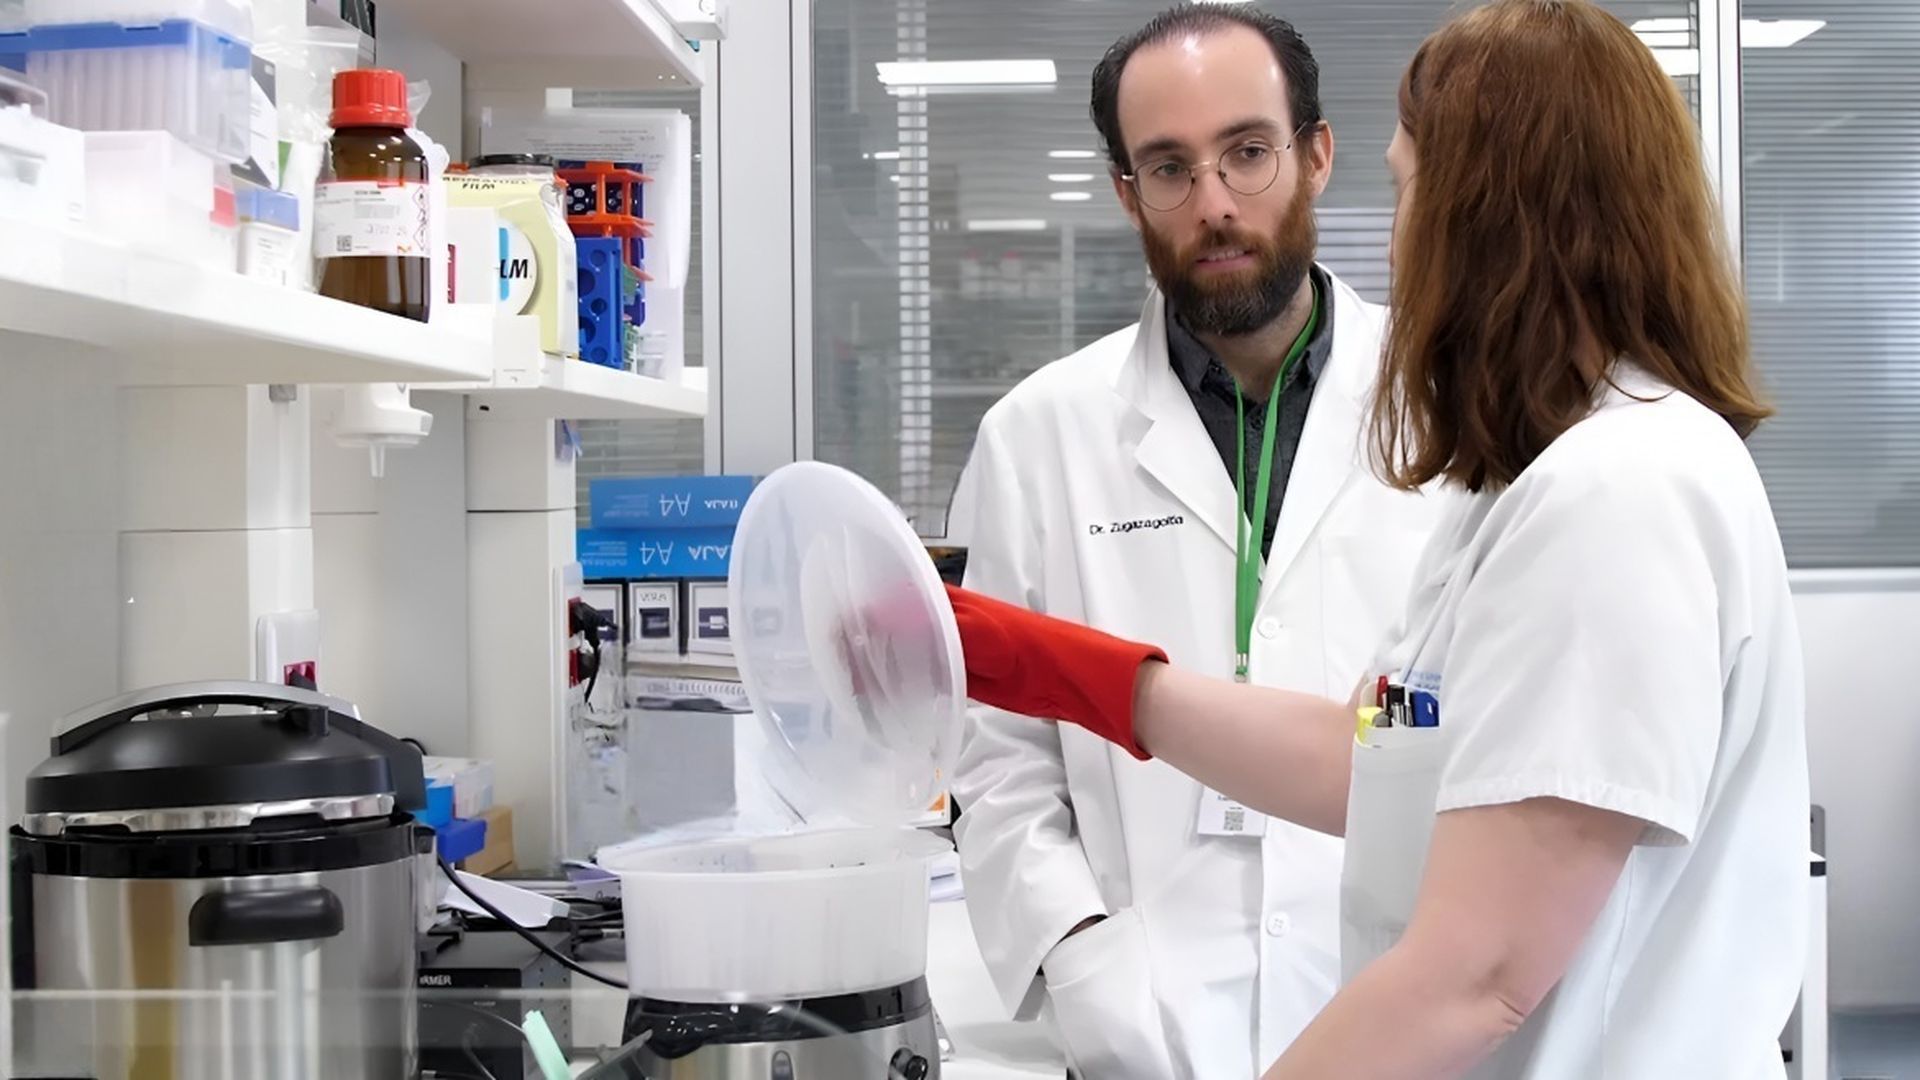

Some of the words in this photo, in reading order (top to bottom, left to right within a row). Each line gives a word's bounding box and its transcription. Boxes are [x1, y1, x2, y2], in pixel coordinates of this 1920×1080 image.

[499, 258, 528, 279] LM
[659, 493, 691, 517] A4
[640, 541, 673, 565] A4
[688, 545, 731, 561] AJA
